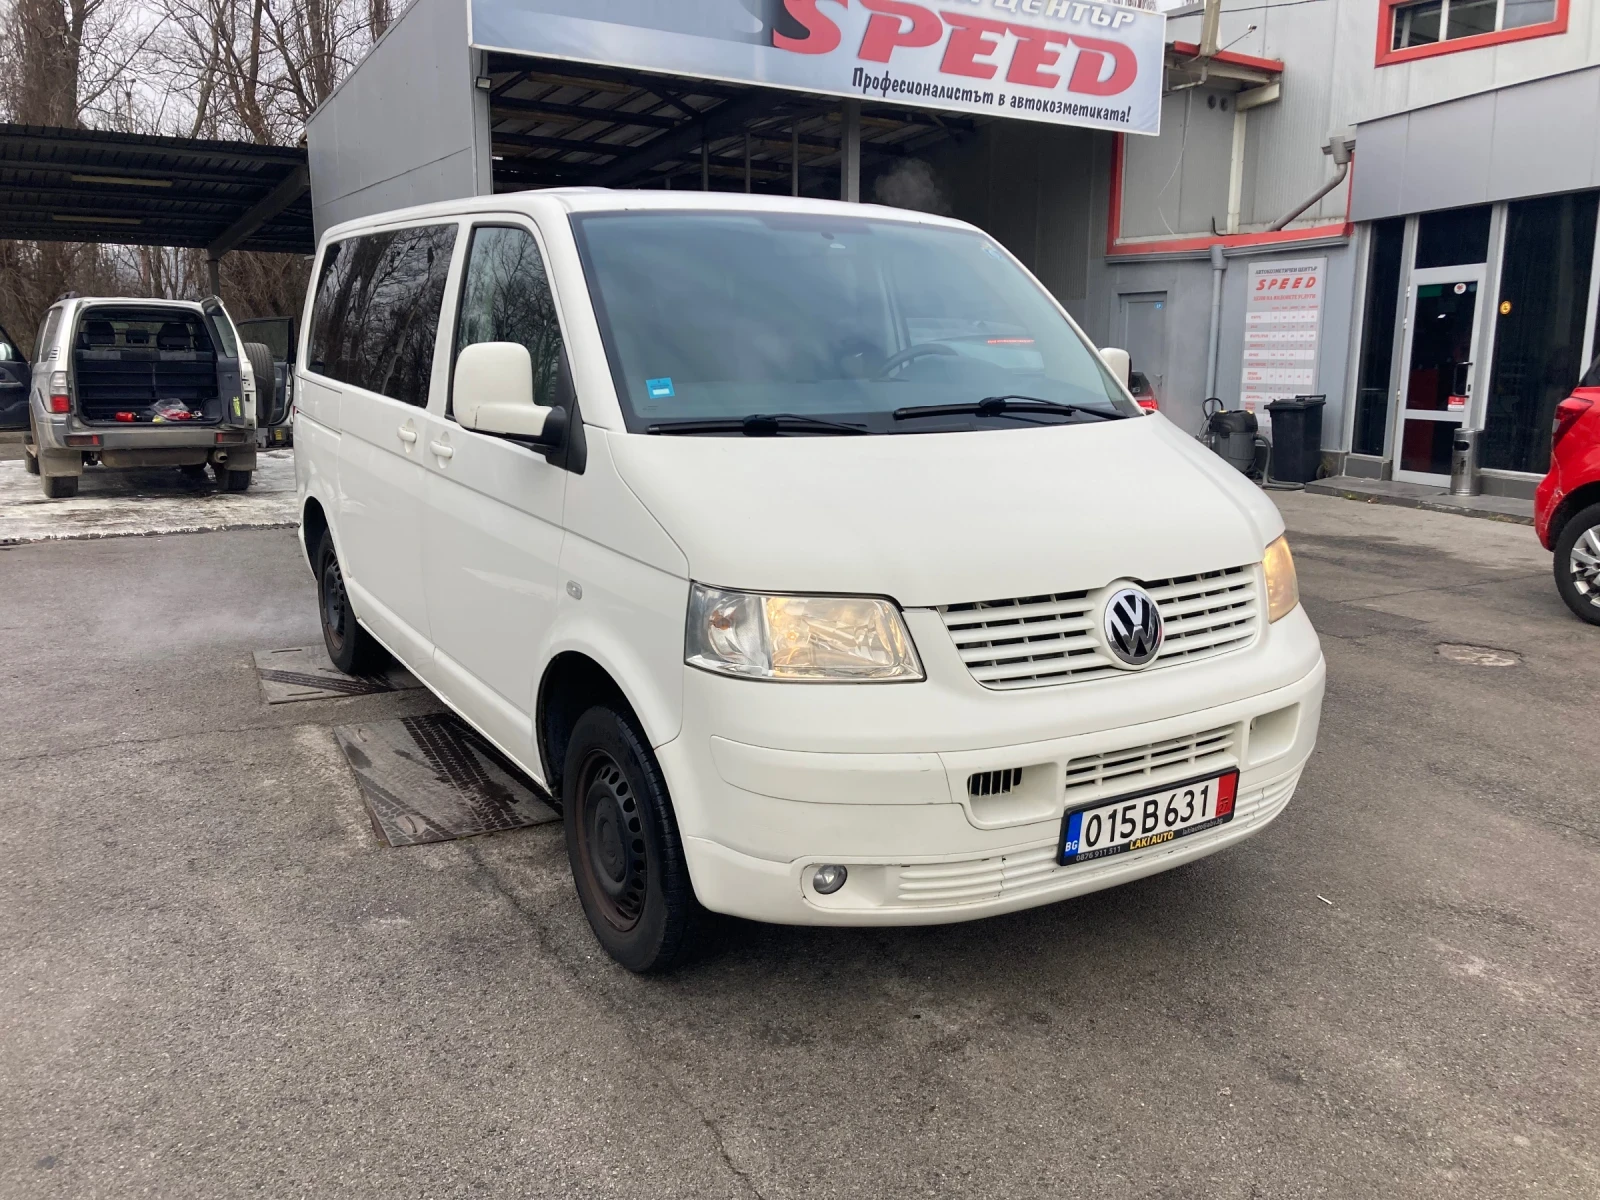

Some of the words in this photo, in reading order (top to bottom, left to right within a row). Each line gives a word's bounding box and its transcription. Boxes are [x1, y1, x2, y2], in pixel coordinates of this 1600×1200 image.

[773, 0, 1138, 96] SPEED
[852, 67, 994, 105] Професионалистът
[998, 94, 1006, 106] в
[1010, 95, 1131, 123] автокозметиката!
[1256, 276, 1316, 291] SPEED
[1065, 840, 1078, 852] BG
[1076, 851, 1094, 861] 0876
[1094, 849, 1107, 858] 911
